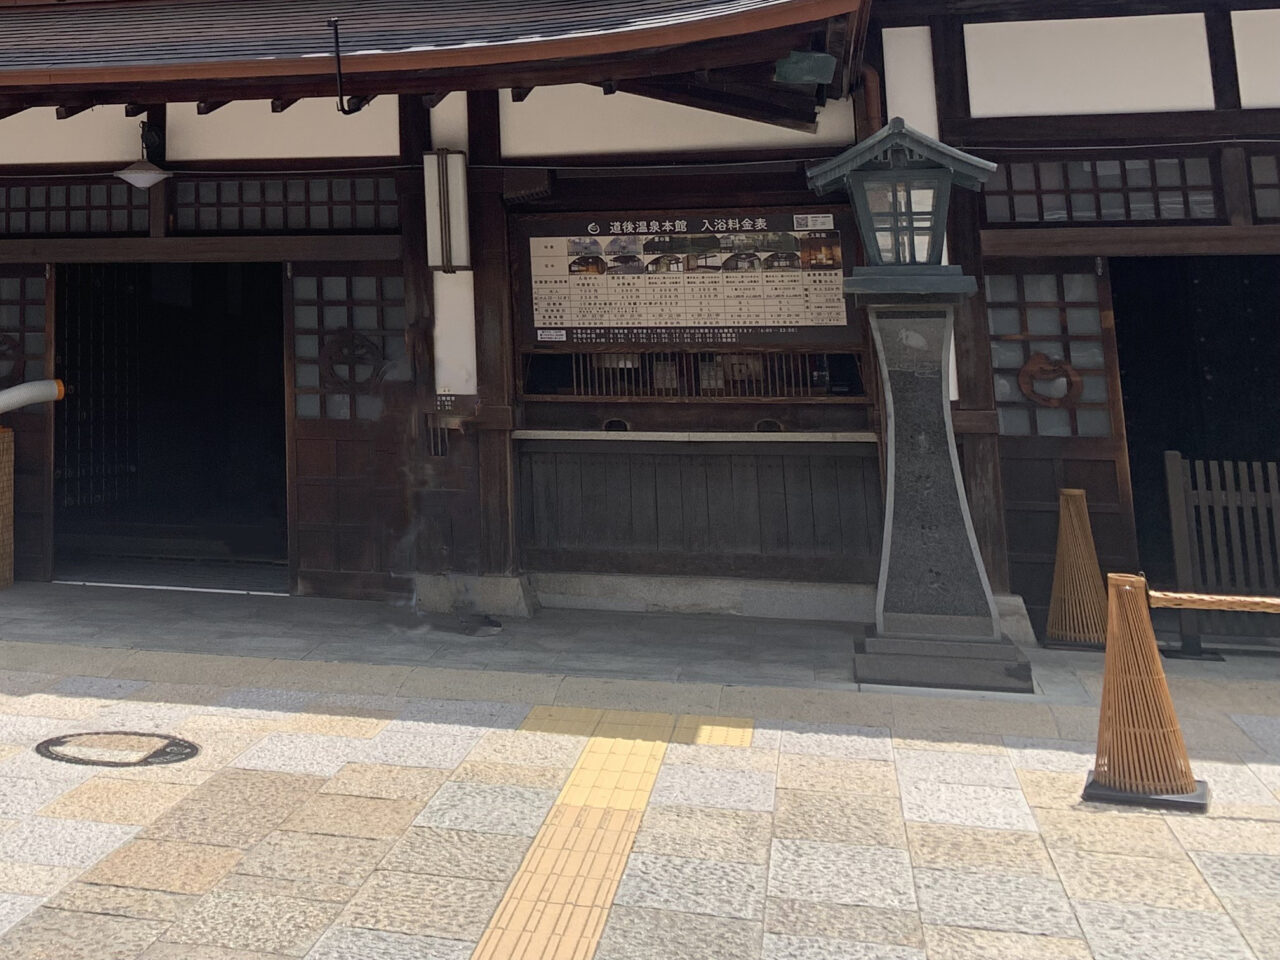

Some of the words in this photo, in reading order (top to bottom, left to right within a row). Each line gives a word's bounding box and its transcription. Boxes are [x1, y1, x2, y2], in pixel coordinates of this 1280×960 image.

[609, 220, 688, 234] 道後温泉本館
[701, 218, 768, 232] 入浴料金表
